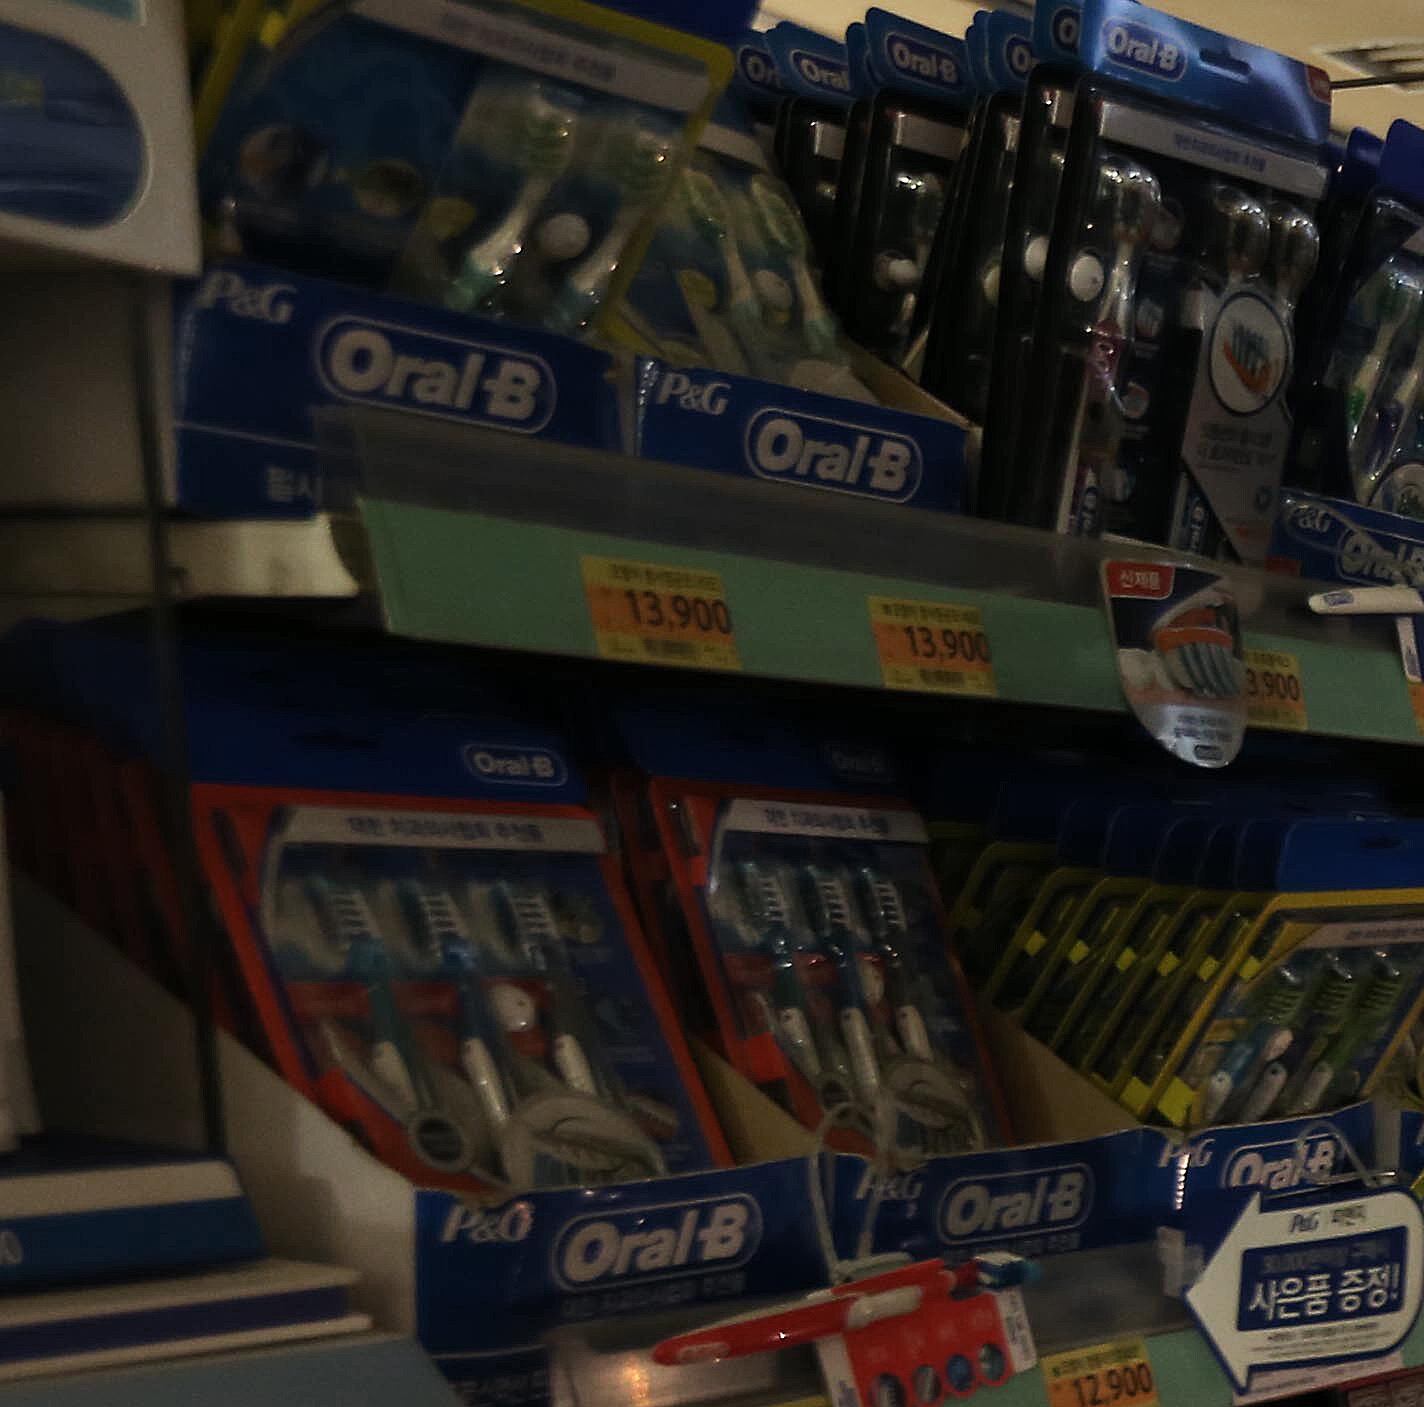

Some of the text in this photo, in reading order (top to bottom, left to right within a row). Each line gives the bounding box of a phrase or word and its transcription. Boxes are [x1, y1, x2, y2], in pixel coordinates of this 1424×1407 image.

[801, 57, 849, 90] Oral
[199, 270, 296, 325] P&G
[329, 328, 540, 421] Oral-B
[657, 370, 731, 416] P&G
[755, 417, 912, 492] Oral-B
[624, 590, 731, 634] 13,900
[904, 625, 992, 664] 13,900
[945, 1167, 1086, 1236] Oral-B
[564, 1203, 749, 1282] Oral-B
[1250, 1263, 1401, 1321] 사은품 증정!
